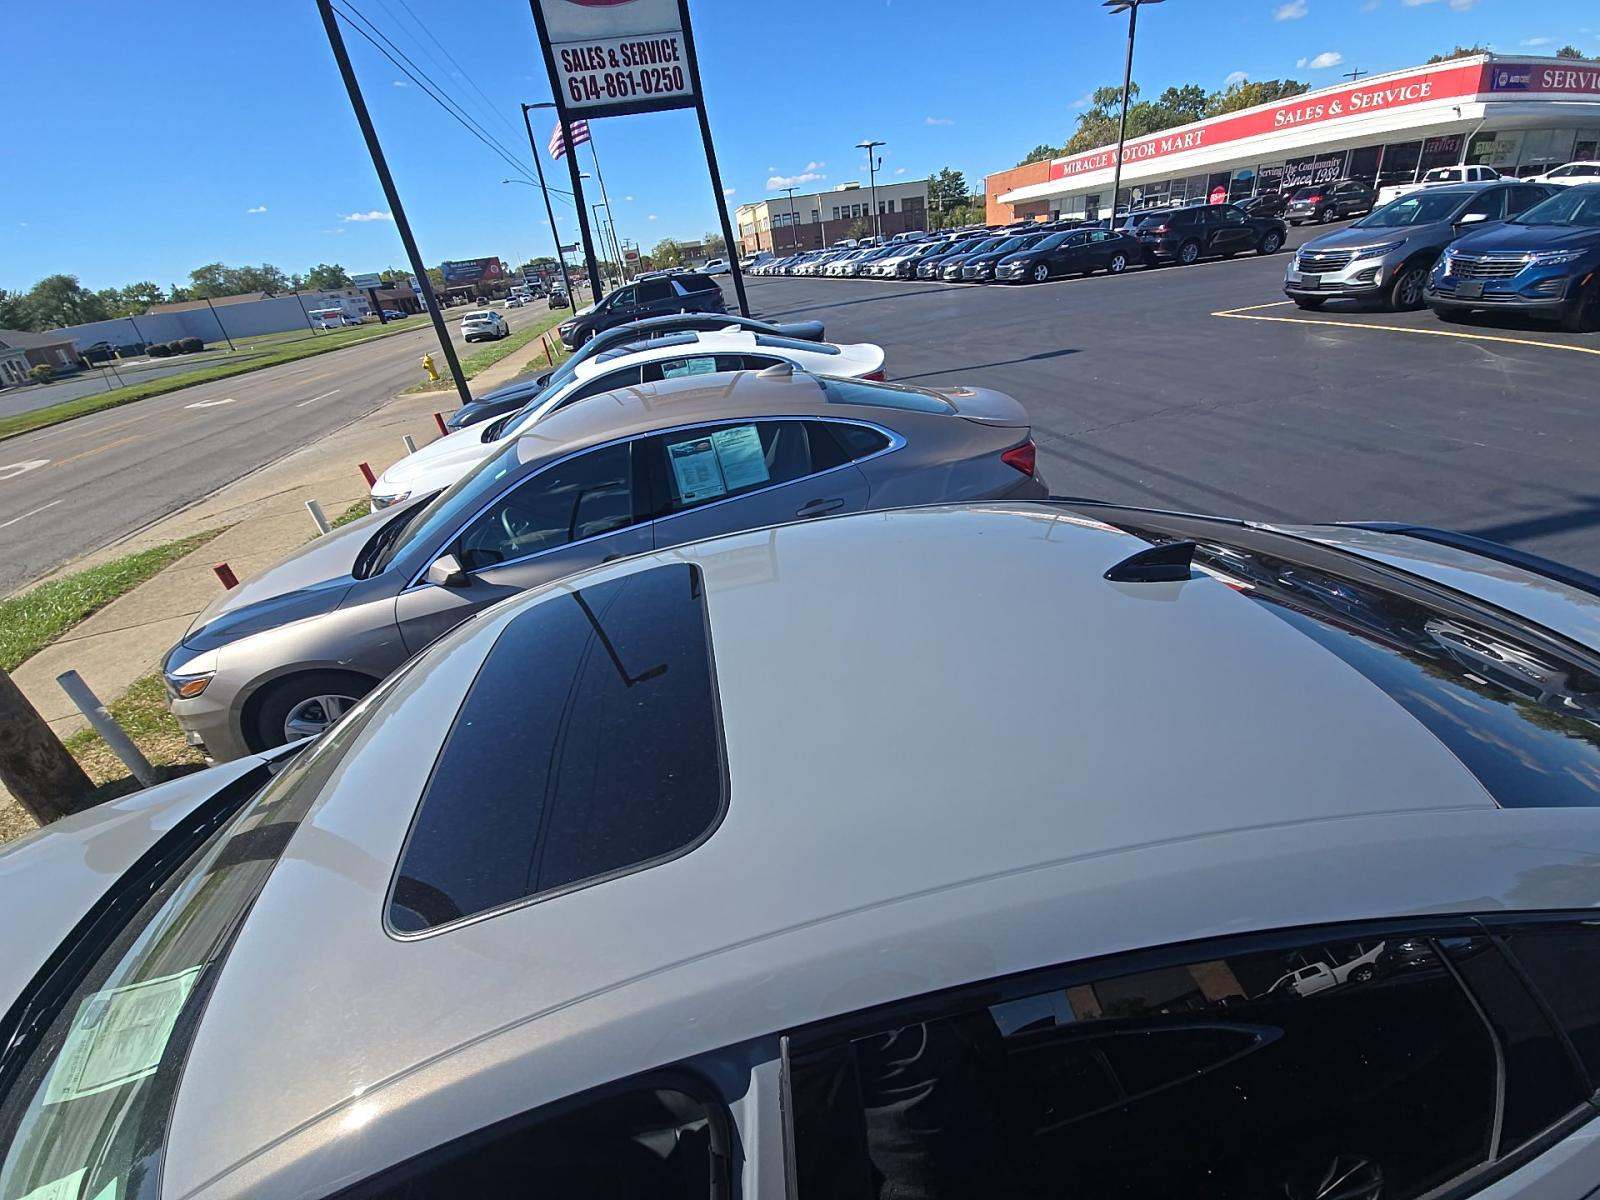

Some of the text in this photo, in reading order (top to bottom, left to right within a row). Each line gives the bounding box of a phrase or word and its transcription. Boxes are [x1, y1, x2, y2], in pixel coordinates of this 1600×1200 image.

[560, 38, 680, 73] SALES & SERVICE
[568, 65, 685, 102] 614-861-0250
[1542, 70, 1600, 89] SERVI
[1274, 82, 1432, 127] SALES & SERVICE
[1063, 154, 1107, 175] MIRACLE
[1160, 130, 1206, 152] MART
[1284, 164, 1298, 174] The
[1314, 167, 1340, 183] 1989
